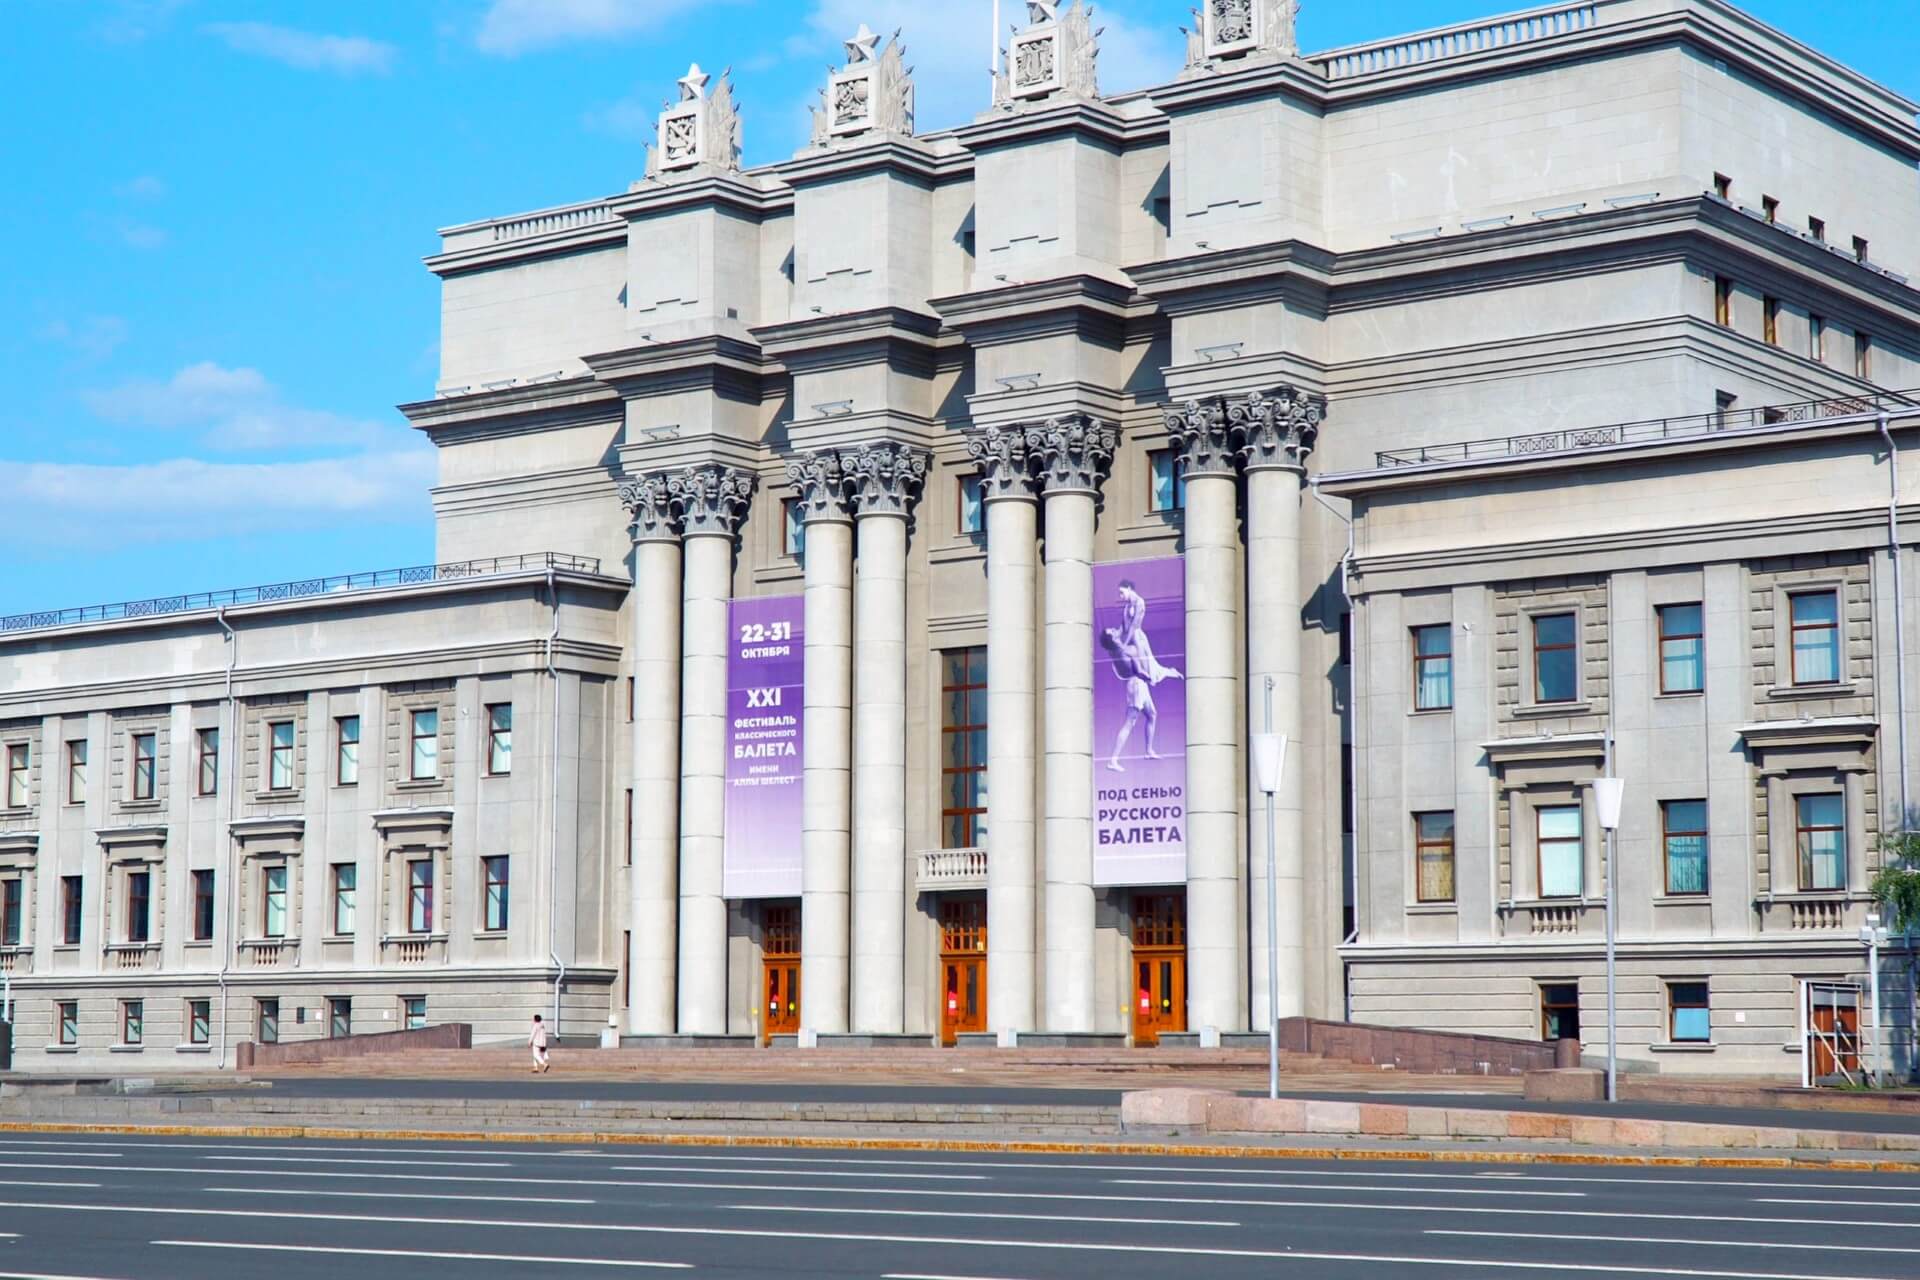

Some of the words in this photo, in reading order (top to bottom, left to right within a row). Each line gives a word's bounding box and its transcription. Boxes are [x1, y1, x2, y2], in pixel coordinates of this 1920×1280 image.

[741, 622, 791, 643] 22-31
[741, 646, 790, 658] ОКТЯБРЯ
[734, 715, 797, 728] ФЕСТИВАЛЬ
[734, 742, 796, 759] БАЛЕТА
[1098, 789, 1128, 802] ПОД
[1131, 786, 1182, 799] СЕНЬЮ
[1098, 806, 1182, 821] РУССКОГО
[1098, 826, 1182, 844] БАЛЕТА
